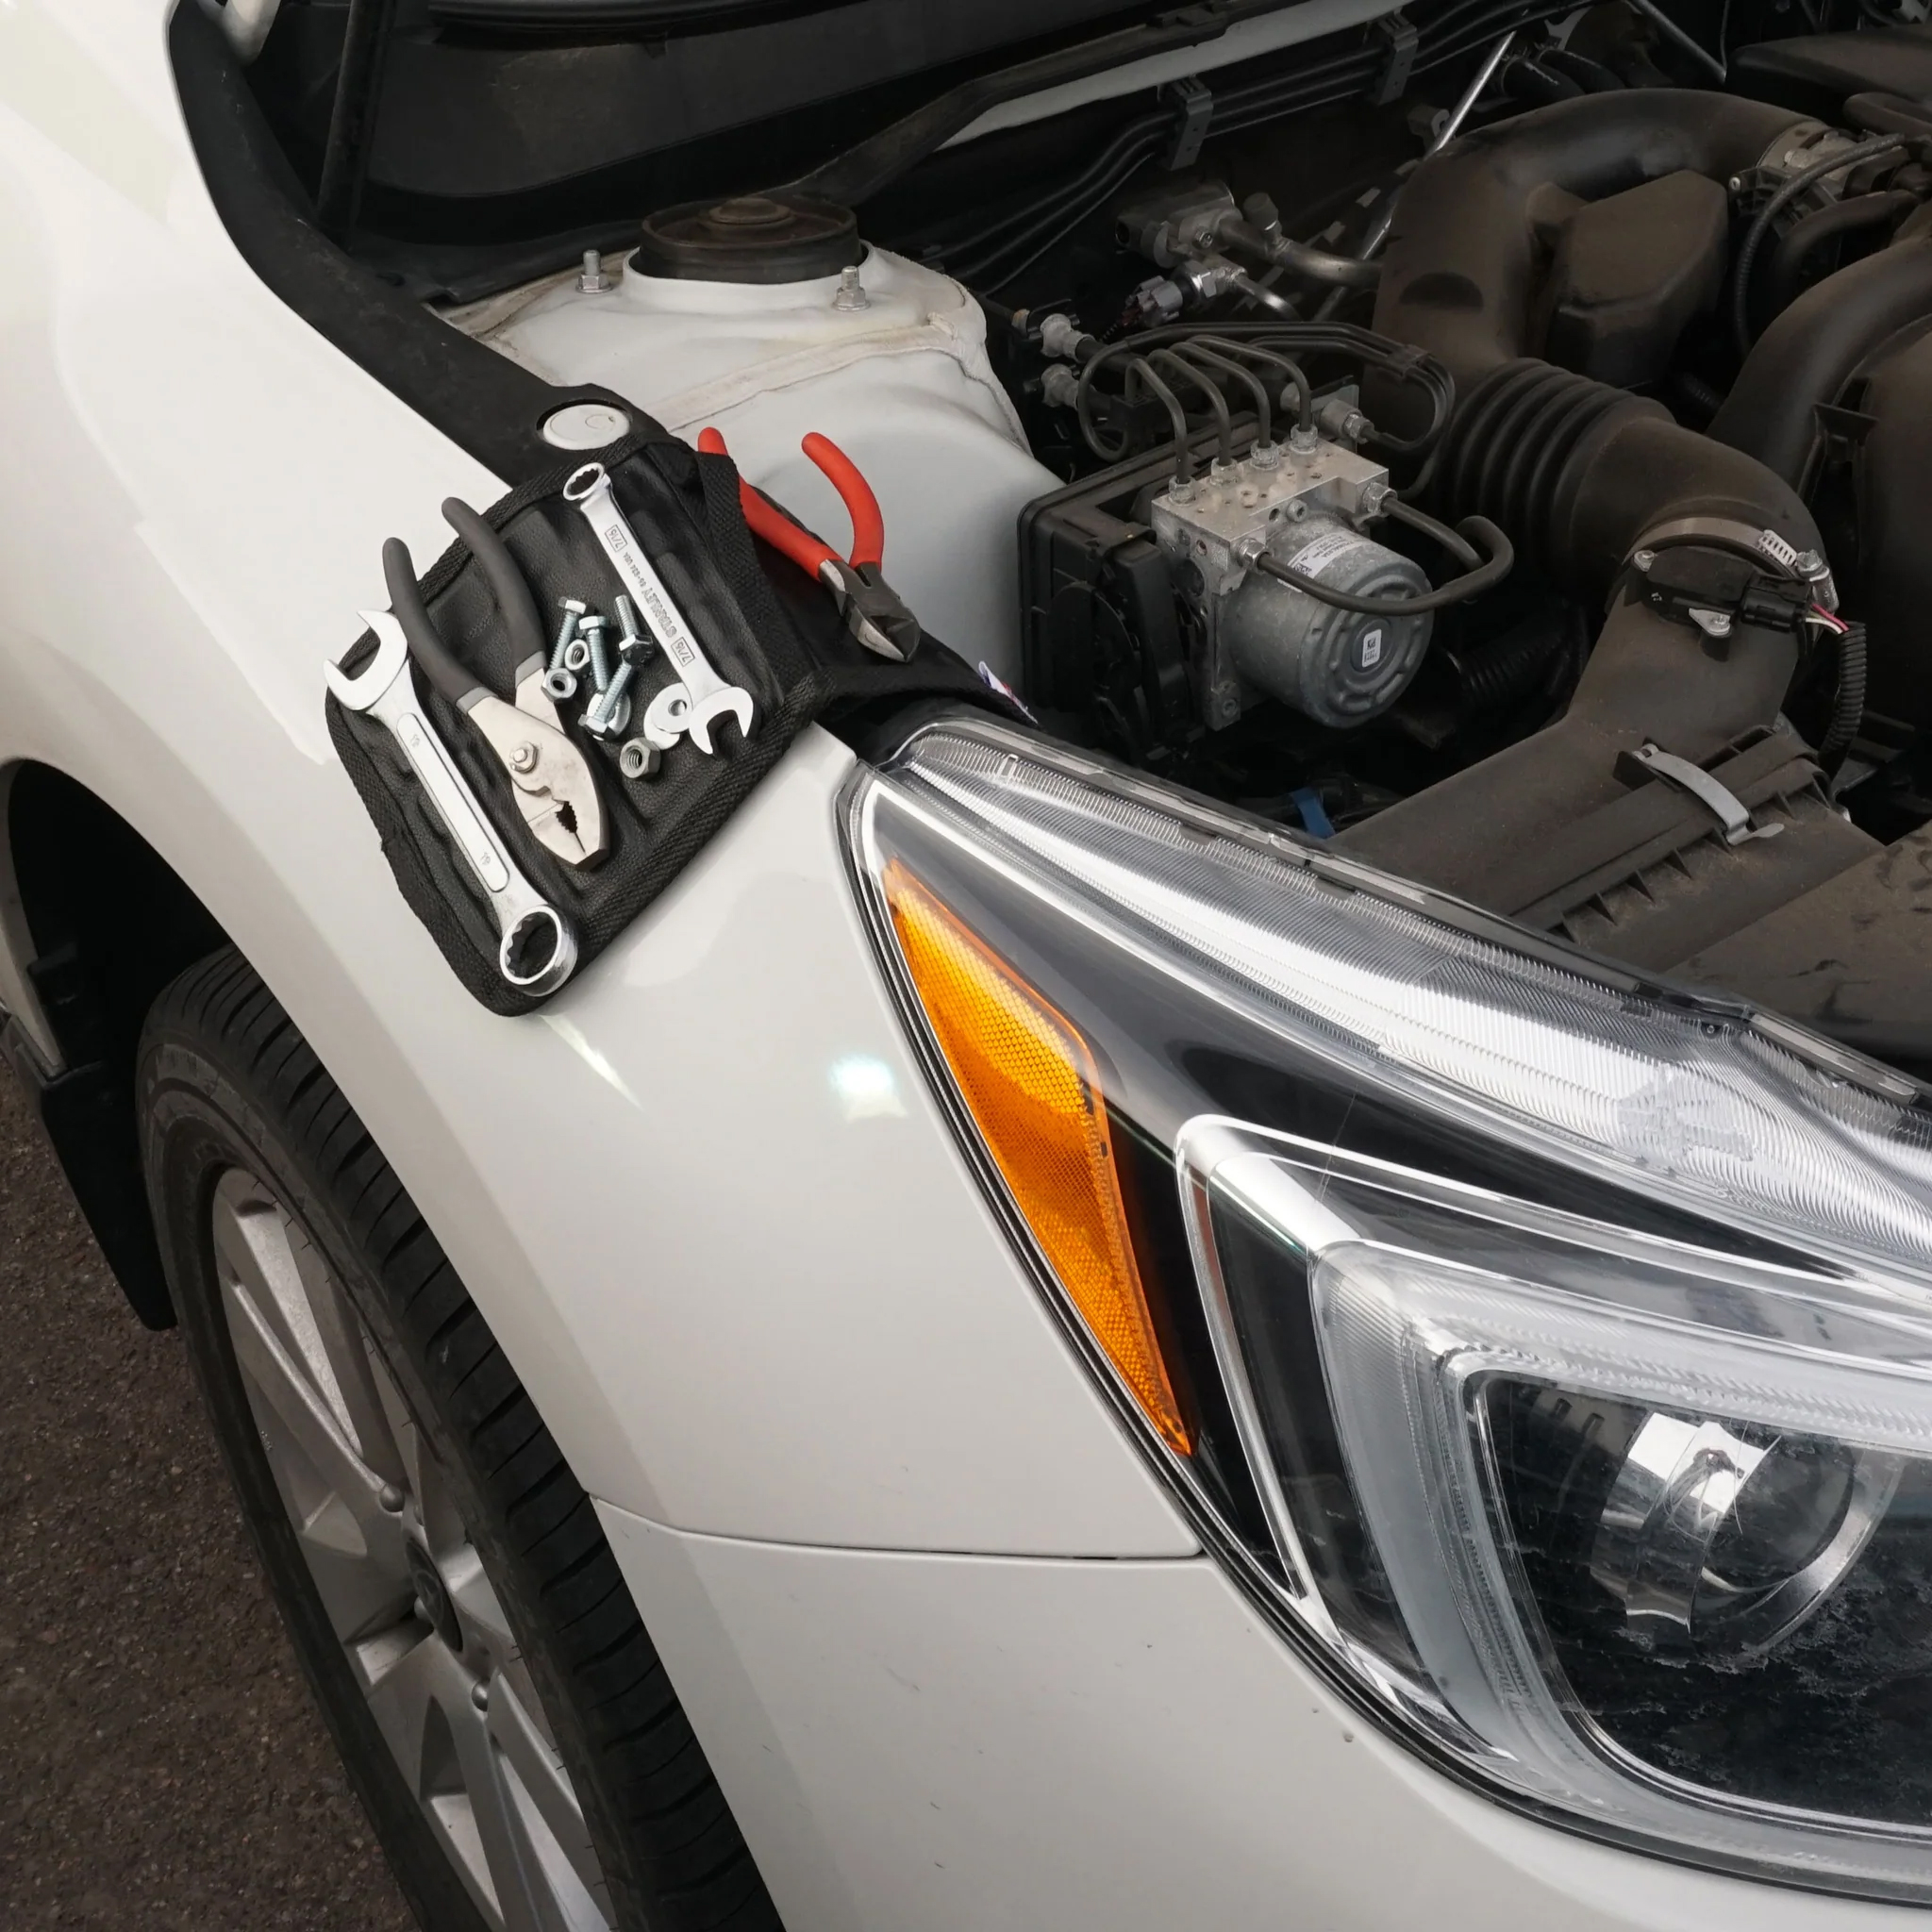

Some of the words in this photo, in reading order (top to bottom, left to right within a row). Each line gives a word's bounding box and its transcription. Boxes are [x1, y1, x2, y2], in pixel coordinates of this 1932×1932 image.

[608, 528, 624, 549] 7/16
[641, 587, 677, 638] STANLEY
[675, 641, 692, 663] 7/16
